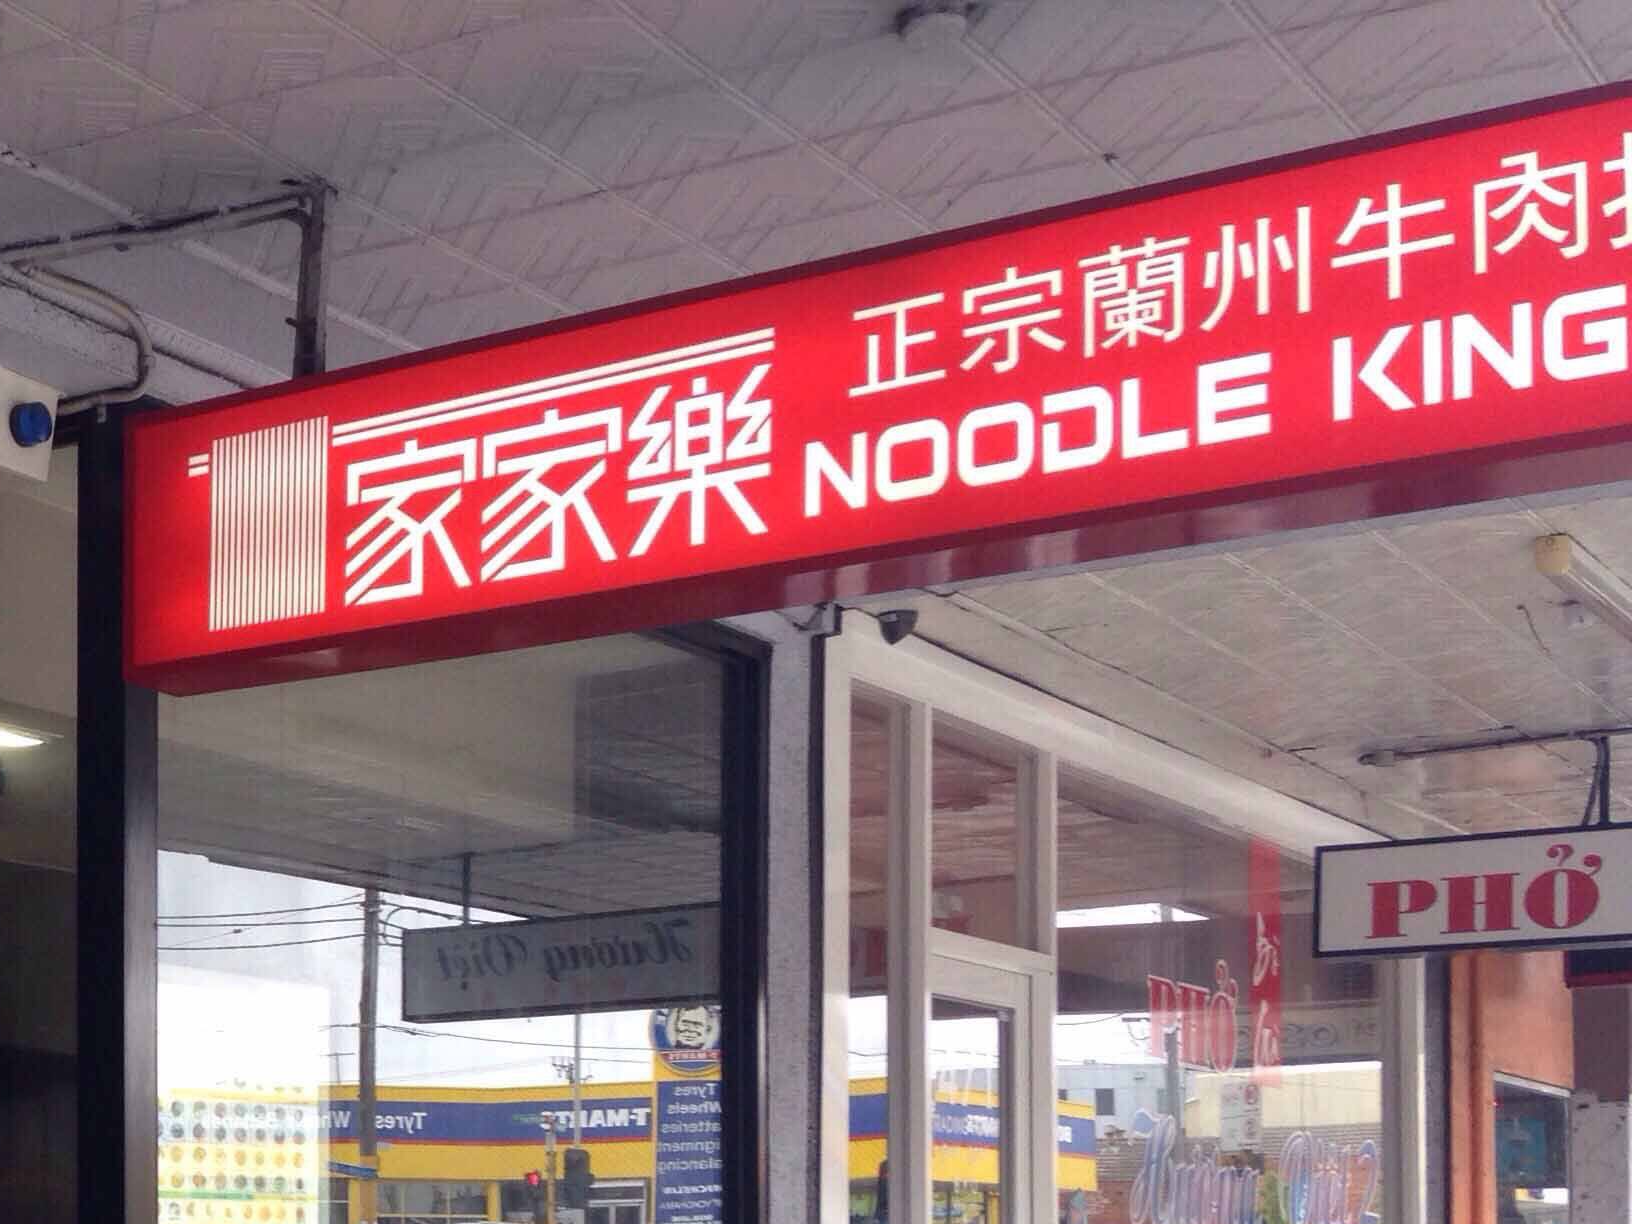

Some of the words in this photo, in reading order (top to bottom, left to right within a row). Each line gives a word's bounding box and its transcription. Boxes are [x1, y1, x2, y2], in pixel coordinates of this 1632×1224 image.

[344, 362, 772, 606] 家家樂
[804, 354, 1272, 518] NOODLE
[1365, 844, 1602, 938] PHỞ
